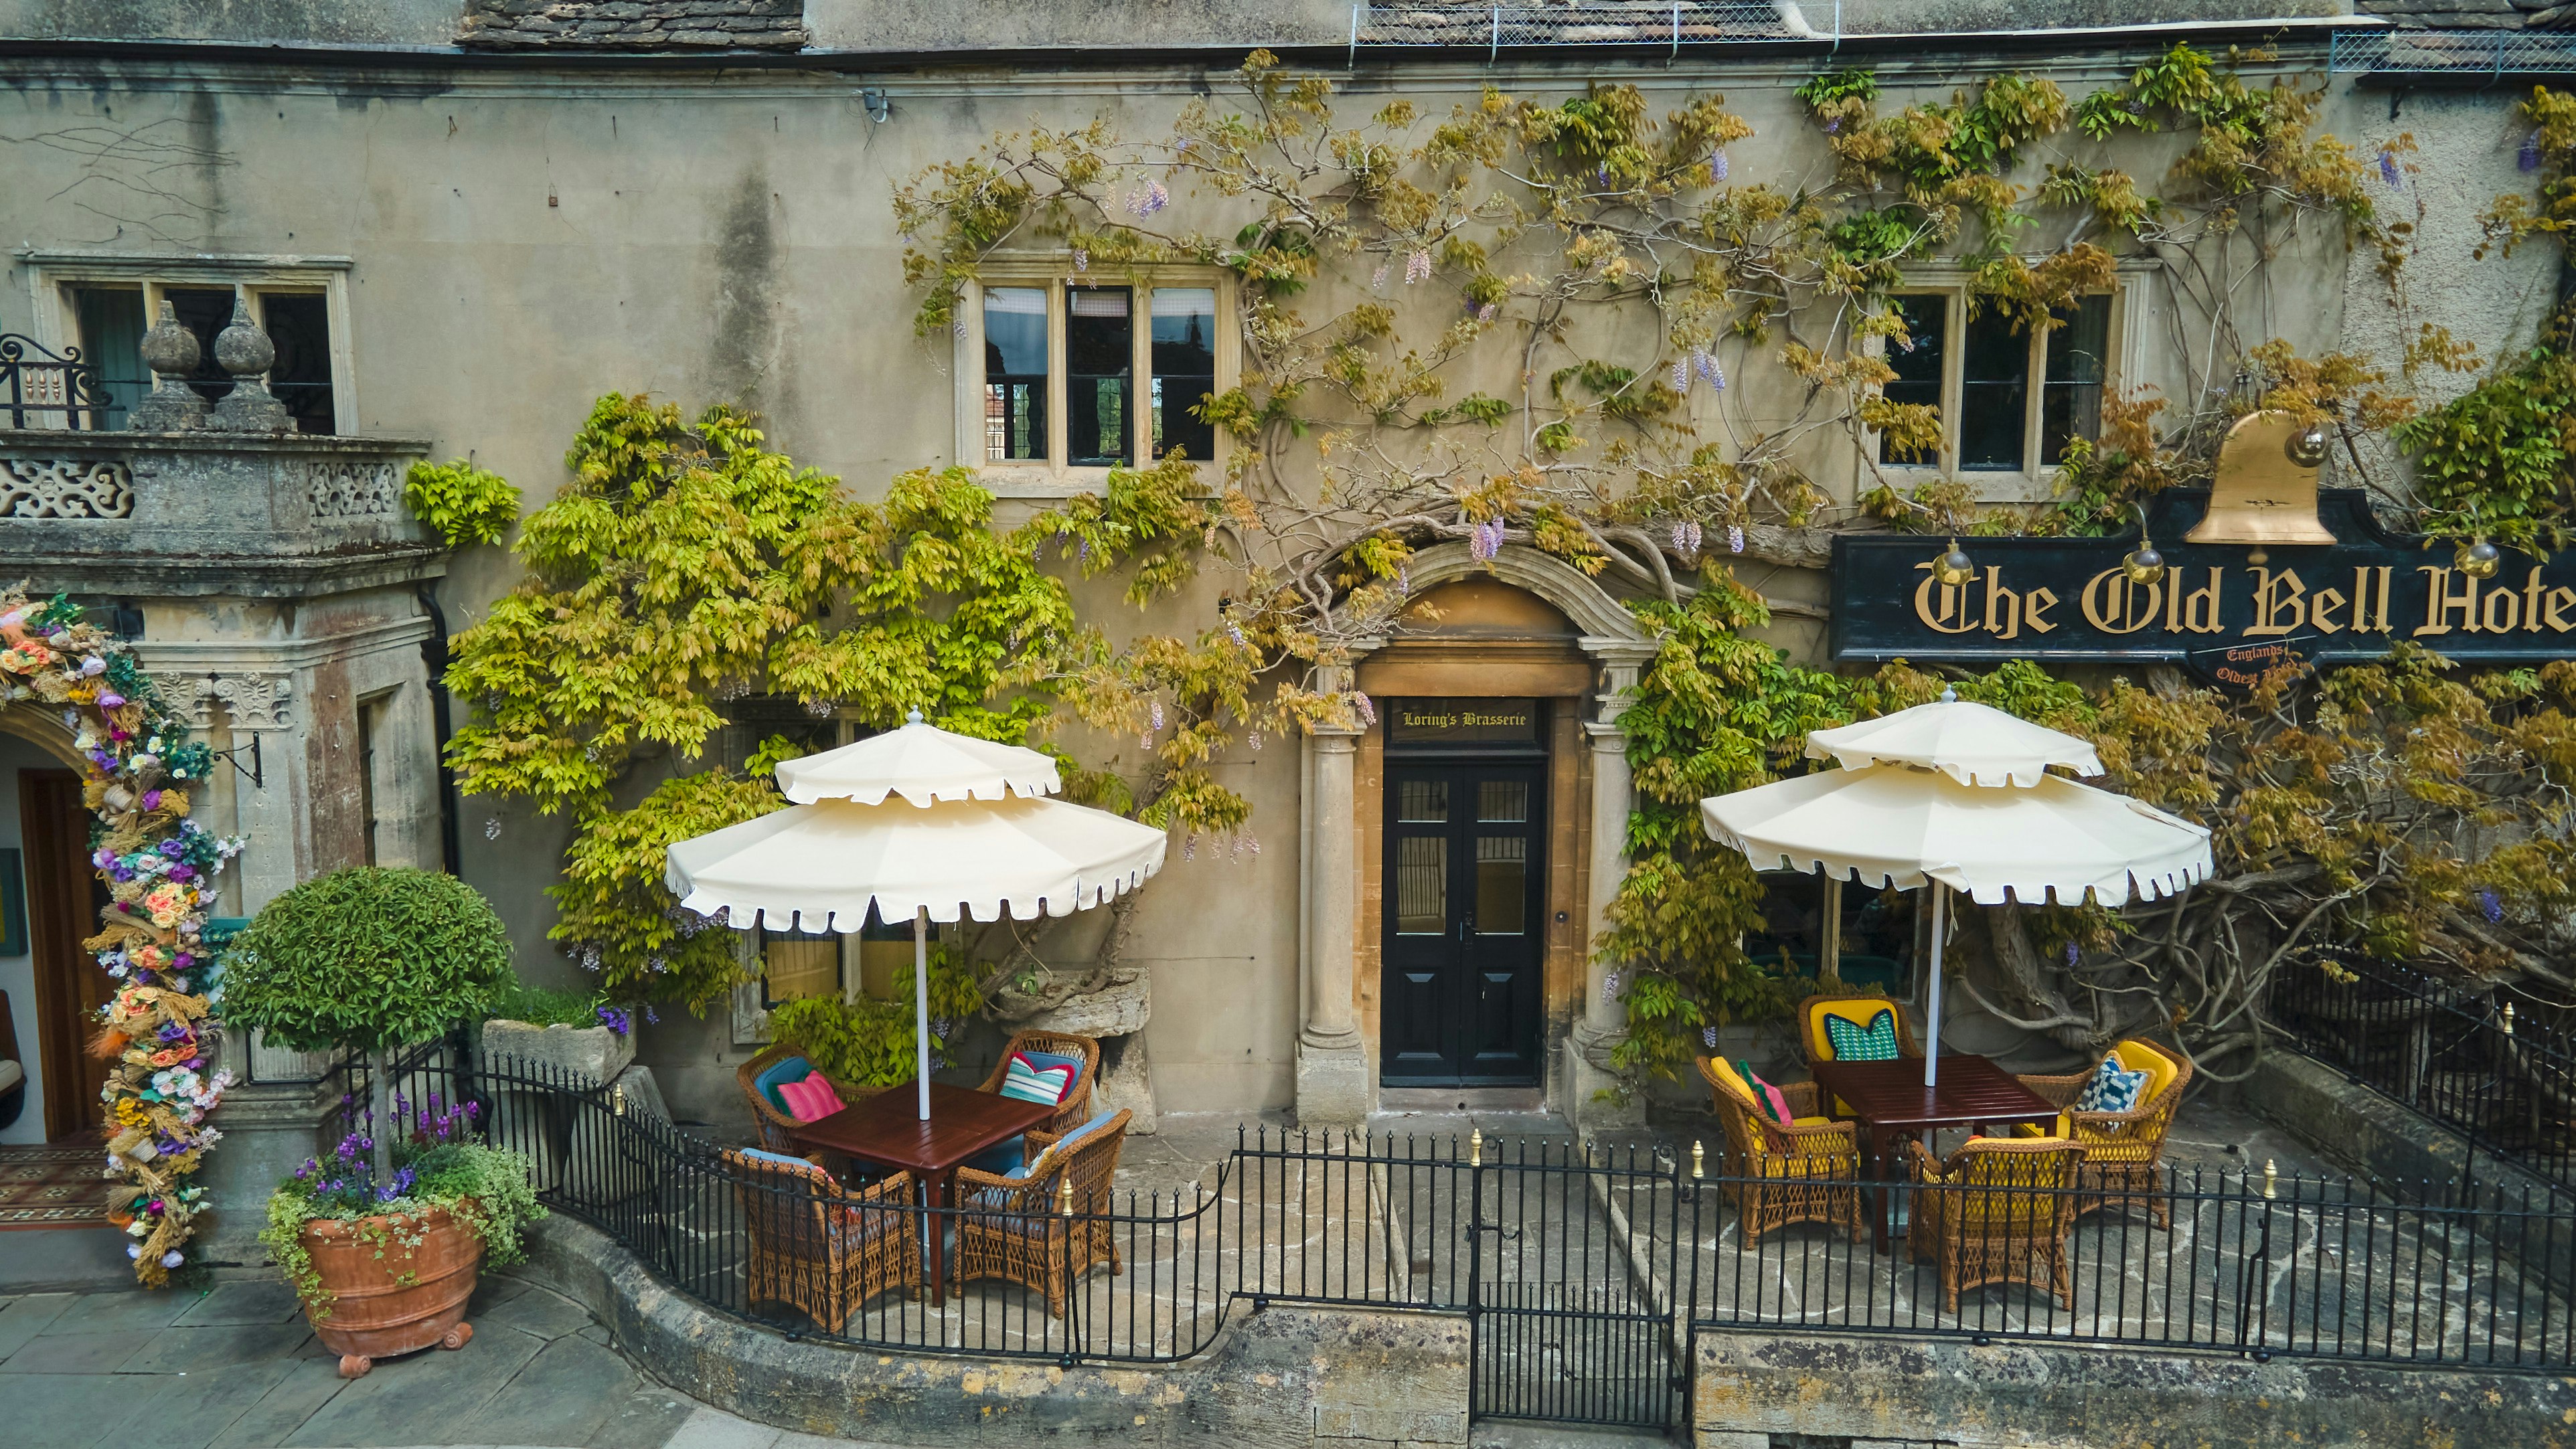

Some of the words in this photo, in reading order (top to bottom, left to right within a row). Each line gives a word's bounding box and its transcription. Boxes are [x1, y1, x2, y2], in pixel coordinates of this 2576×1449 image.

[1914, 562, 2059, 639] The
[2081, 566, 2225, 634] Old
[2243, 566, 2394, 636] Bell
[2413, 566, 2576, 637] Hote
[2227, 645, 2283, 662] Englands
[1403, 712, 1457, 728] Loring's
[1462, 712, 1526, 728] Brasserie
